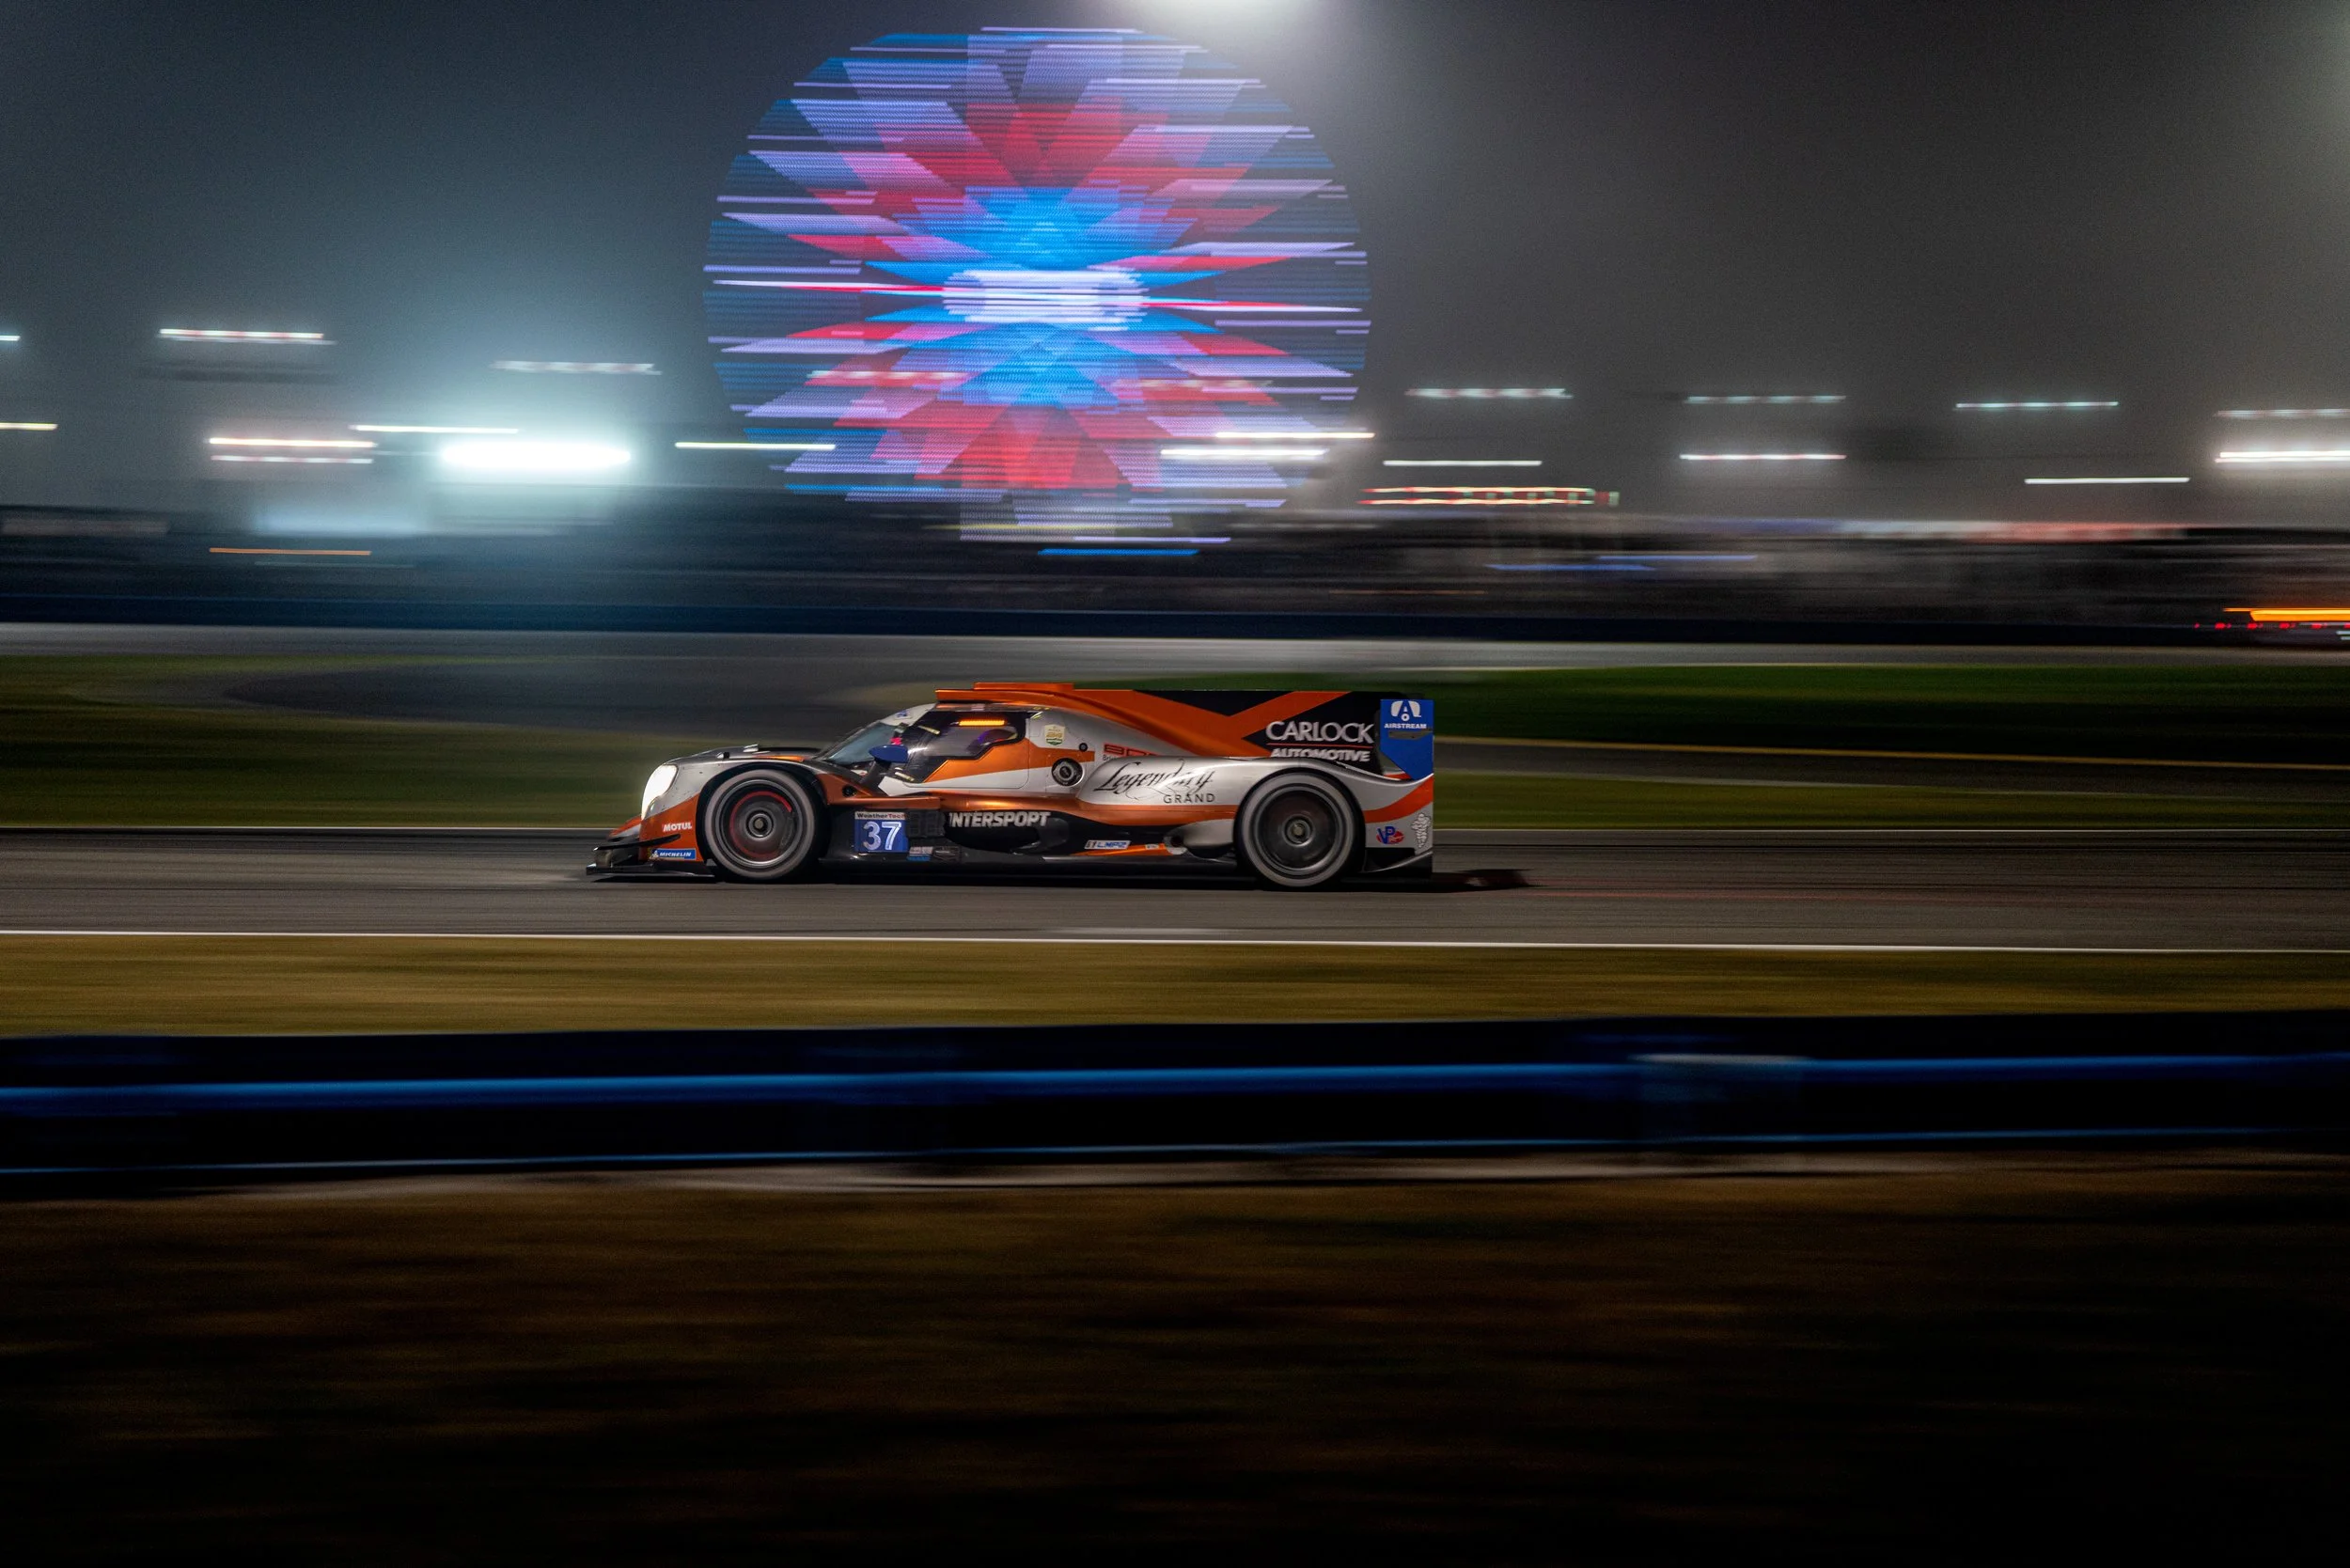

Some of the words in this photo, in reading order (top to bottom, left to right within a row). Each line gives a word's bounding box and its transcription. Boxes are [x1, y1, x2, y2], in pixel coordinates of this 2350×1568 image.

[1265, 720, 1374, 744] CARLOCK
[1270, 748, 1371, 761] AUTOMOTIVE
[1163, 792, 1215, 804] GRAND
[663, 822, 693, 833] MOTUL
[863, 821, 902, 851] 37
